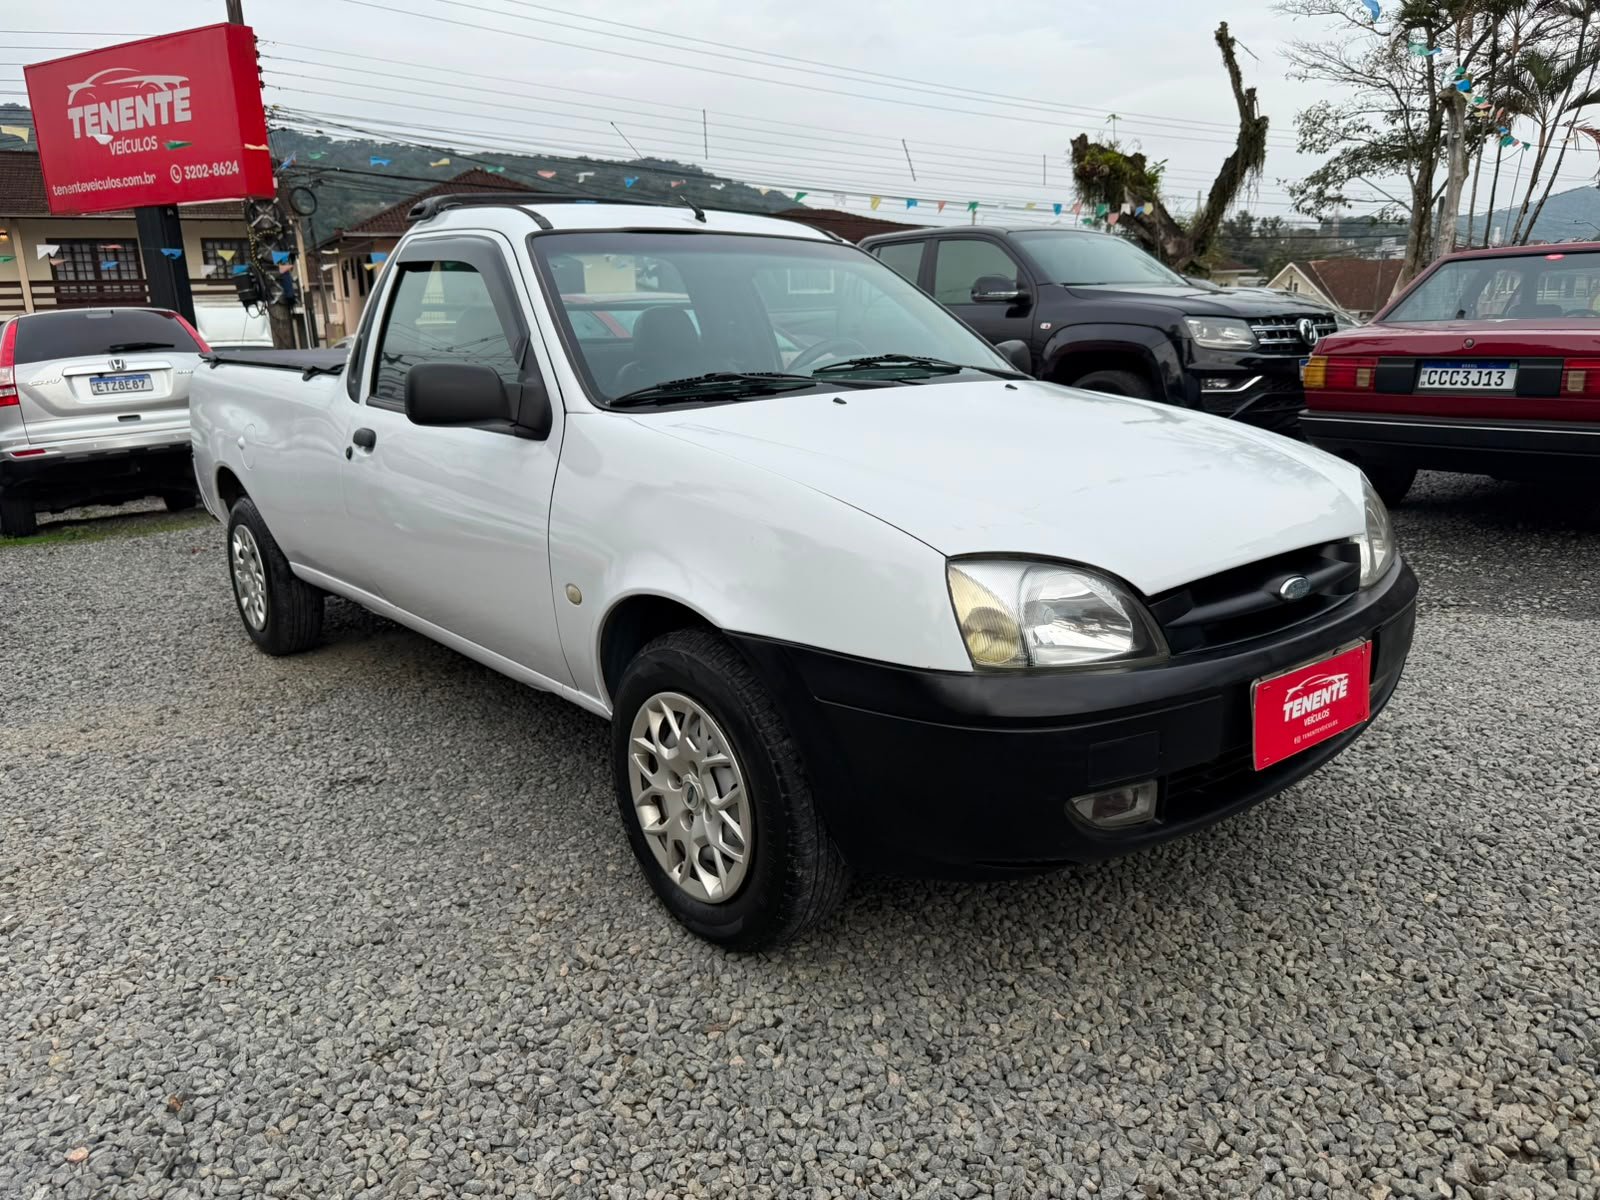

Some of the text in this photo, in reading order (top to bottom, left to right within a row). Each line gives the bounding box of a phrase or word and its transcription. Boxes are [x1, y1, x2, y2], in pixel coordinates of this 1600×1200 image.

[67, 87, 192, 139] TENENTE
[109, 135, 158, 156] VEÍCULOS
[184, 160, 240, 180] 3202-8624
[52, 171, 156, 197] tenenteveiculos.com.br
[1427, 370, 1506, 387] CCC3J13
[1282, 679, 1349, 722] TENENTE
[1303, 708, 1331, 727] VEÍCULOS
